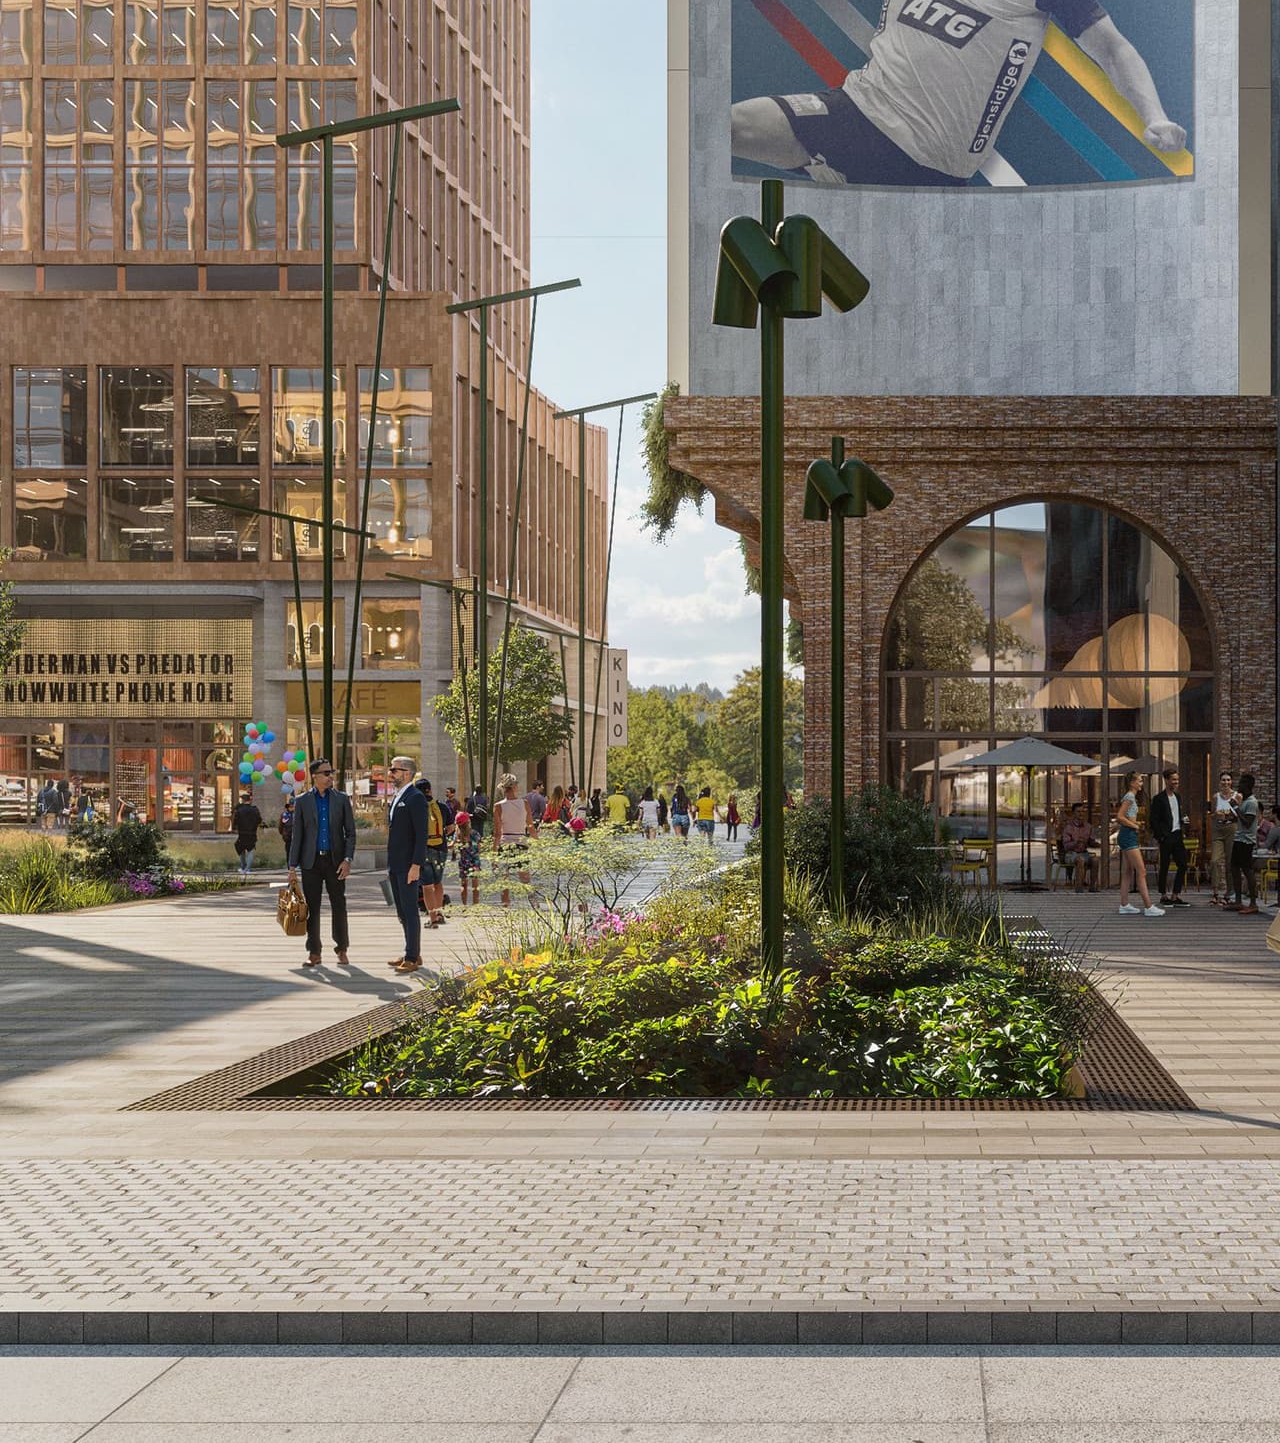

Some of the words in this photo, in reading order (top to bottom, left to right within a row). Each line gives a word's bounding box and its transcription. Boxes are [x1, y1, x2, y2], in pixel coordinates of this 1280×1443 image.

[973, 65, 1018, 152] Gjensidige
[3, 653, 100, 675] IDERMAN
[107, 653, 130, 675] VS
[136, 653, 234, 675] PREDATOR
[116, 681, 176, 703] PHONE
[183, 681, 234, 703] HOME
[612, 657, 624, 738] KINO
